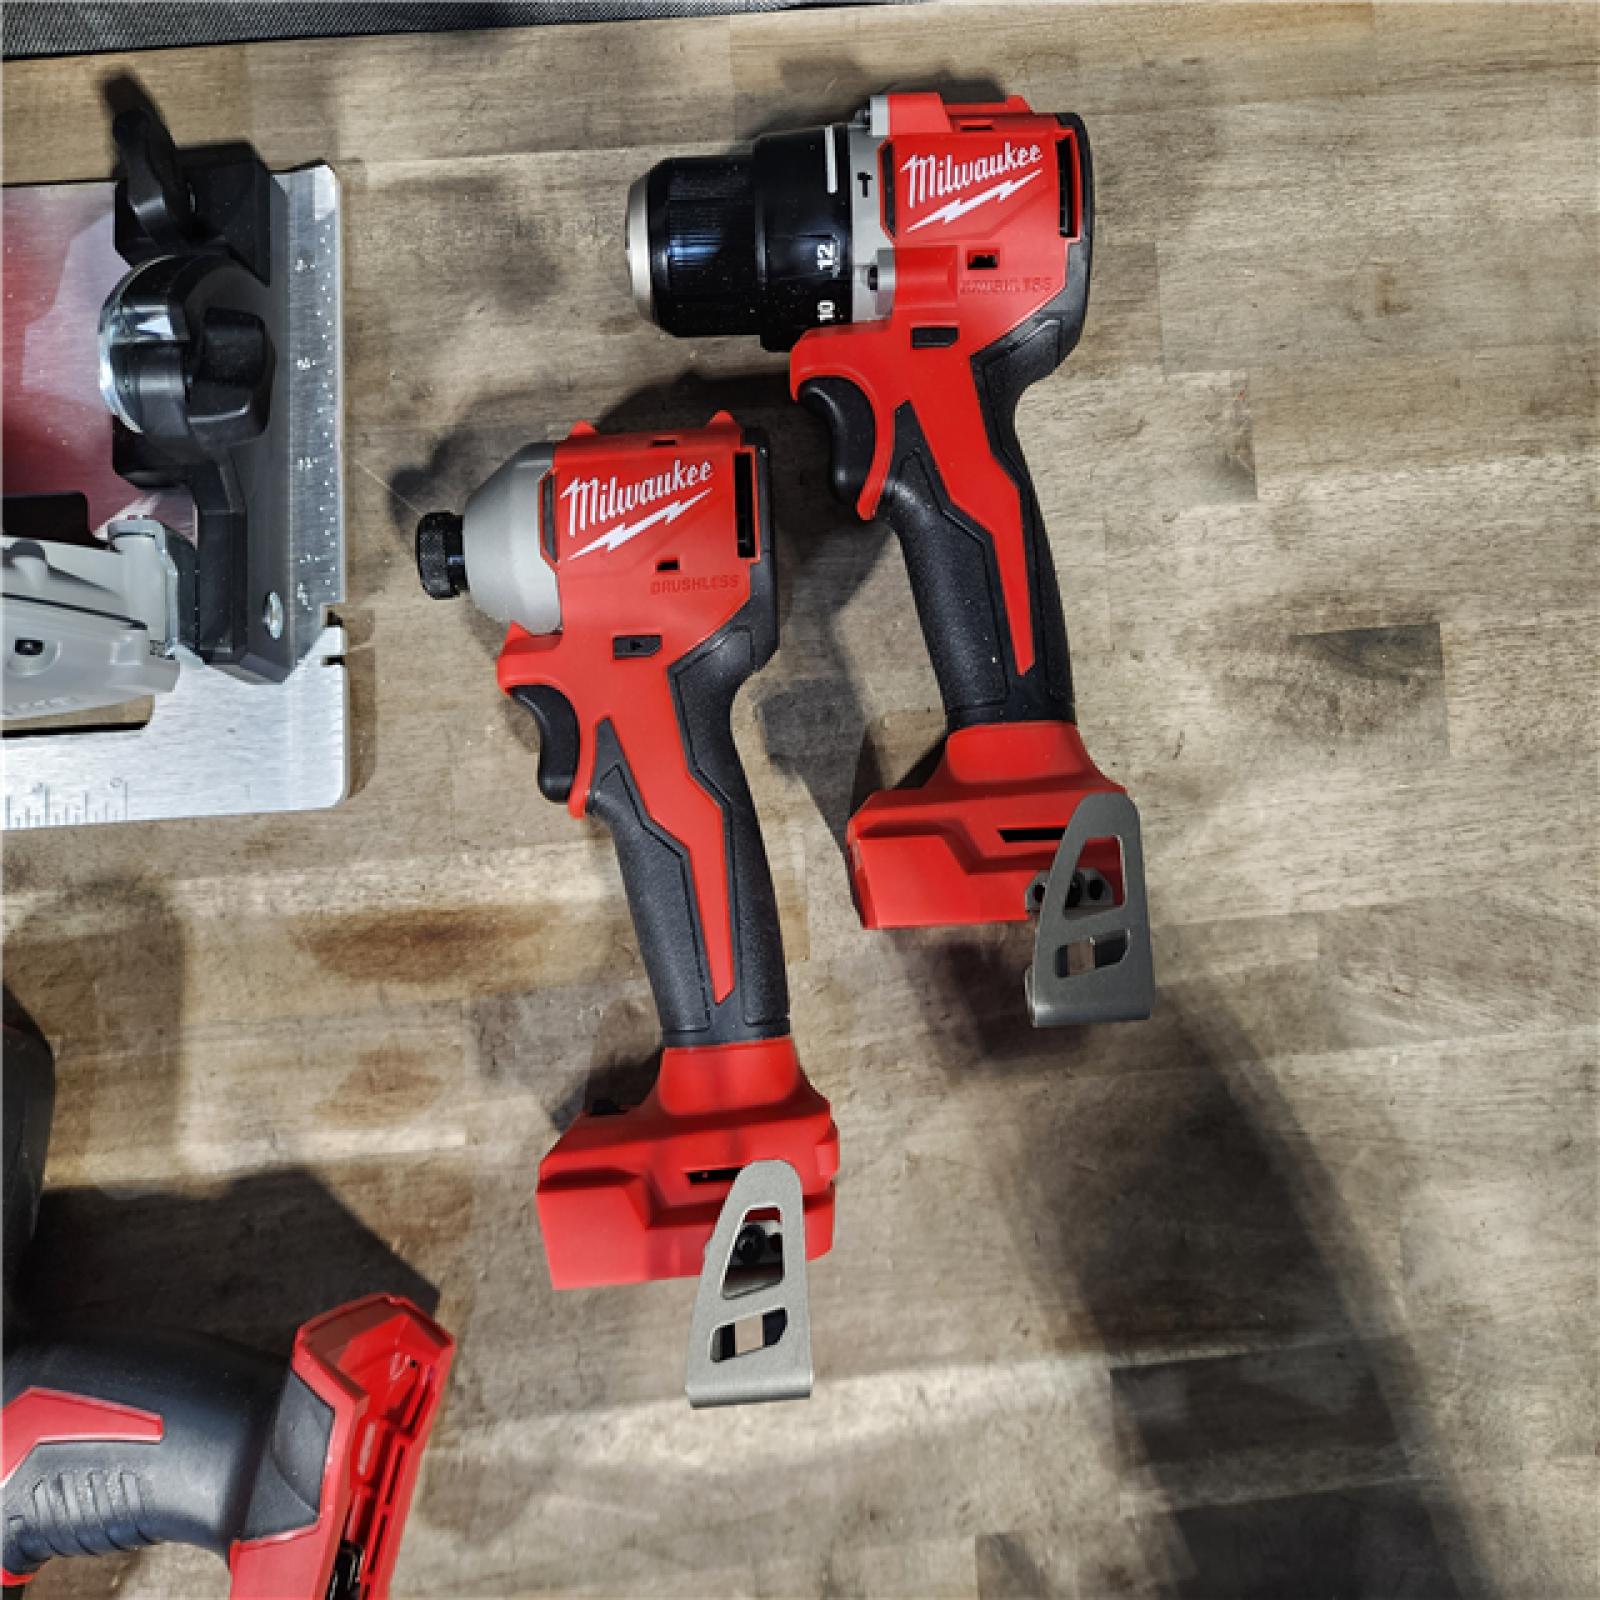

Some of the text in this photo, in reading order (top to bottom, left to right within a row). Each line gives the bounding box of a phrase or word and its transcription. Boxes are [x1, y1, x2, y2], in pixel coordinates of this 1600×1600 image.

[900, 140, 1043, 208] Milwaukee
[817, 244, 834, 271] 12
[560, 459, 713, 537] Milwaukee
